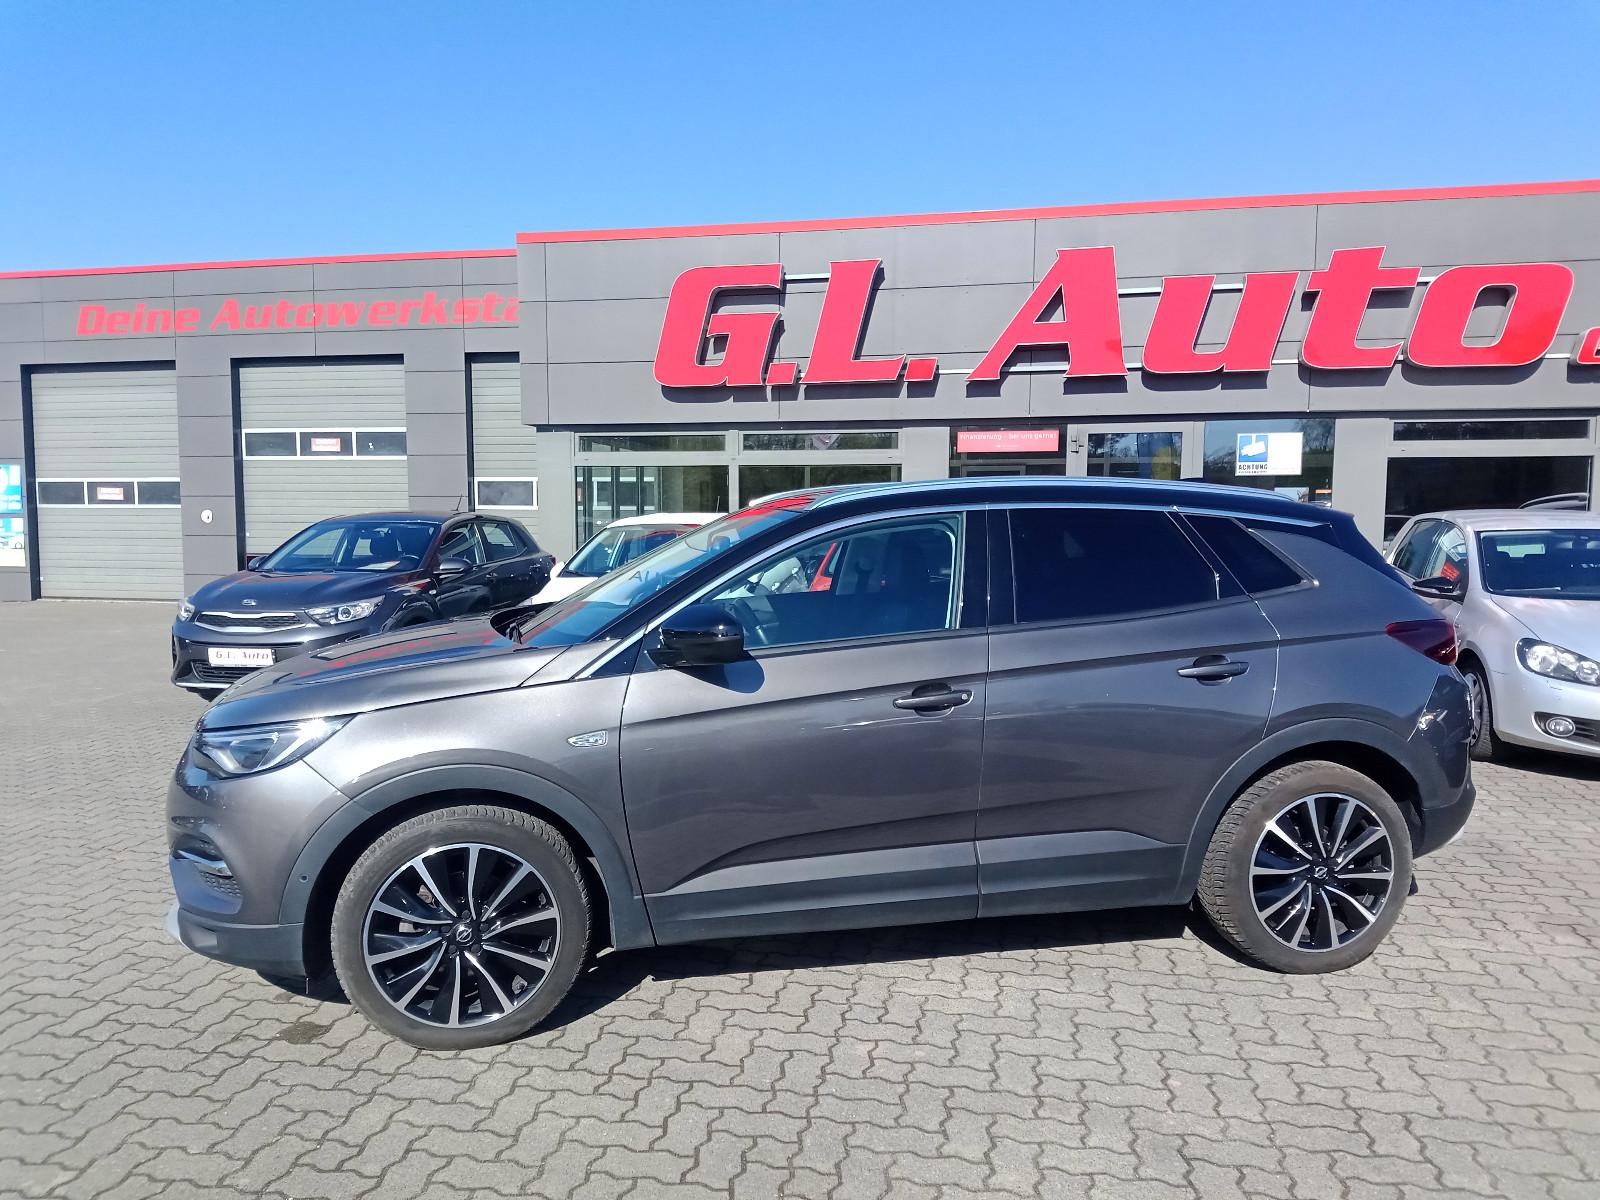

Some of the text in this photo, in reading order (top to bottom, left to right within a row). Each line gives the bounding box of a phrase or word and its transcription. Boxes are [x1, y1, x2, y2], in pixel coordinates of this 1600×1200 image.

[77, 303, 201, 336] Deine
[654, 246, 1574, 387] G.L. Auto
